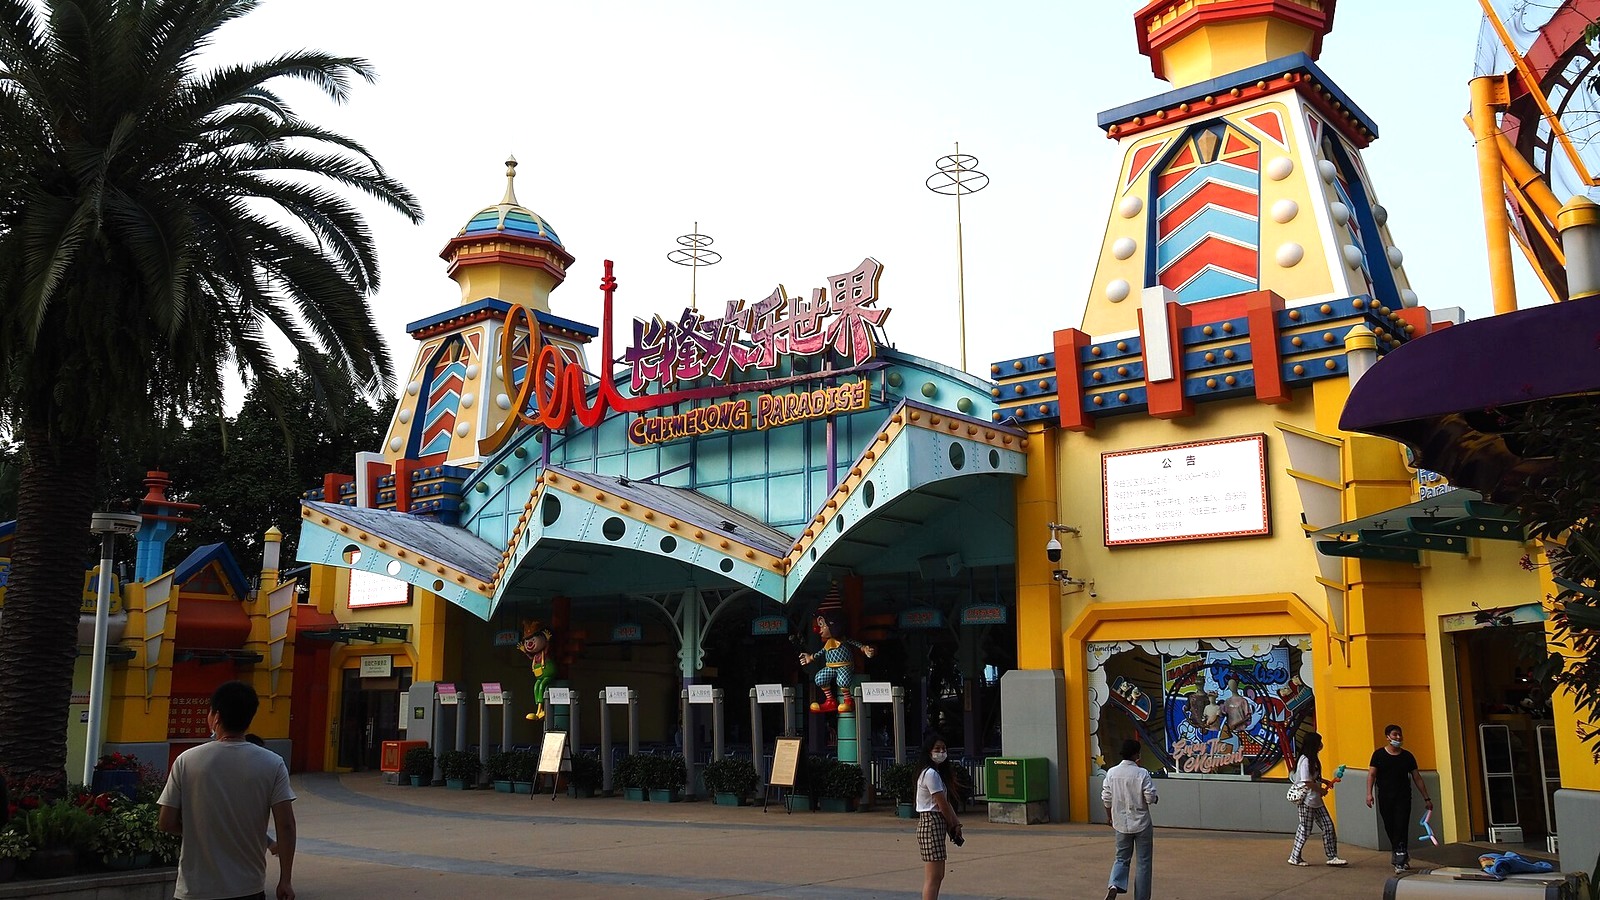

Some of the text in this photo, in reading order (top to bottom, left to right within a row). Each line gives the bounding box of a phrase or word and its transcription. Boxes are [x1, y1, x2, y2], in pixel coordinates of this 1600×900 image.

[625, 256, 891, 392] 长隆欢乐世界
[628, 379, 871, 446] CHIMELONG PARADISE
[997, 769, 1015, 795] E
